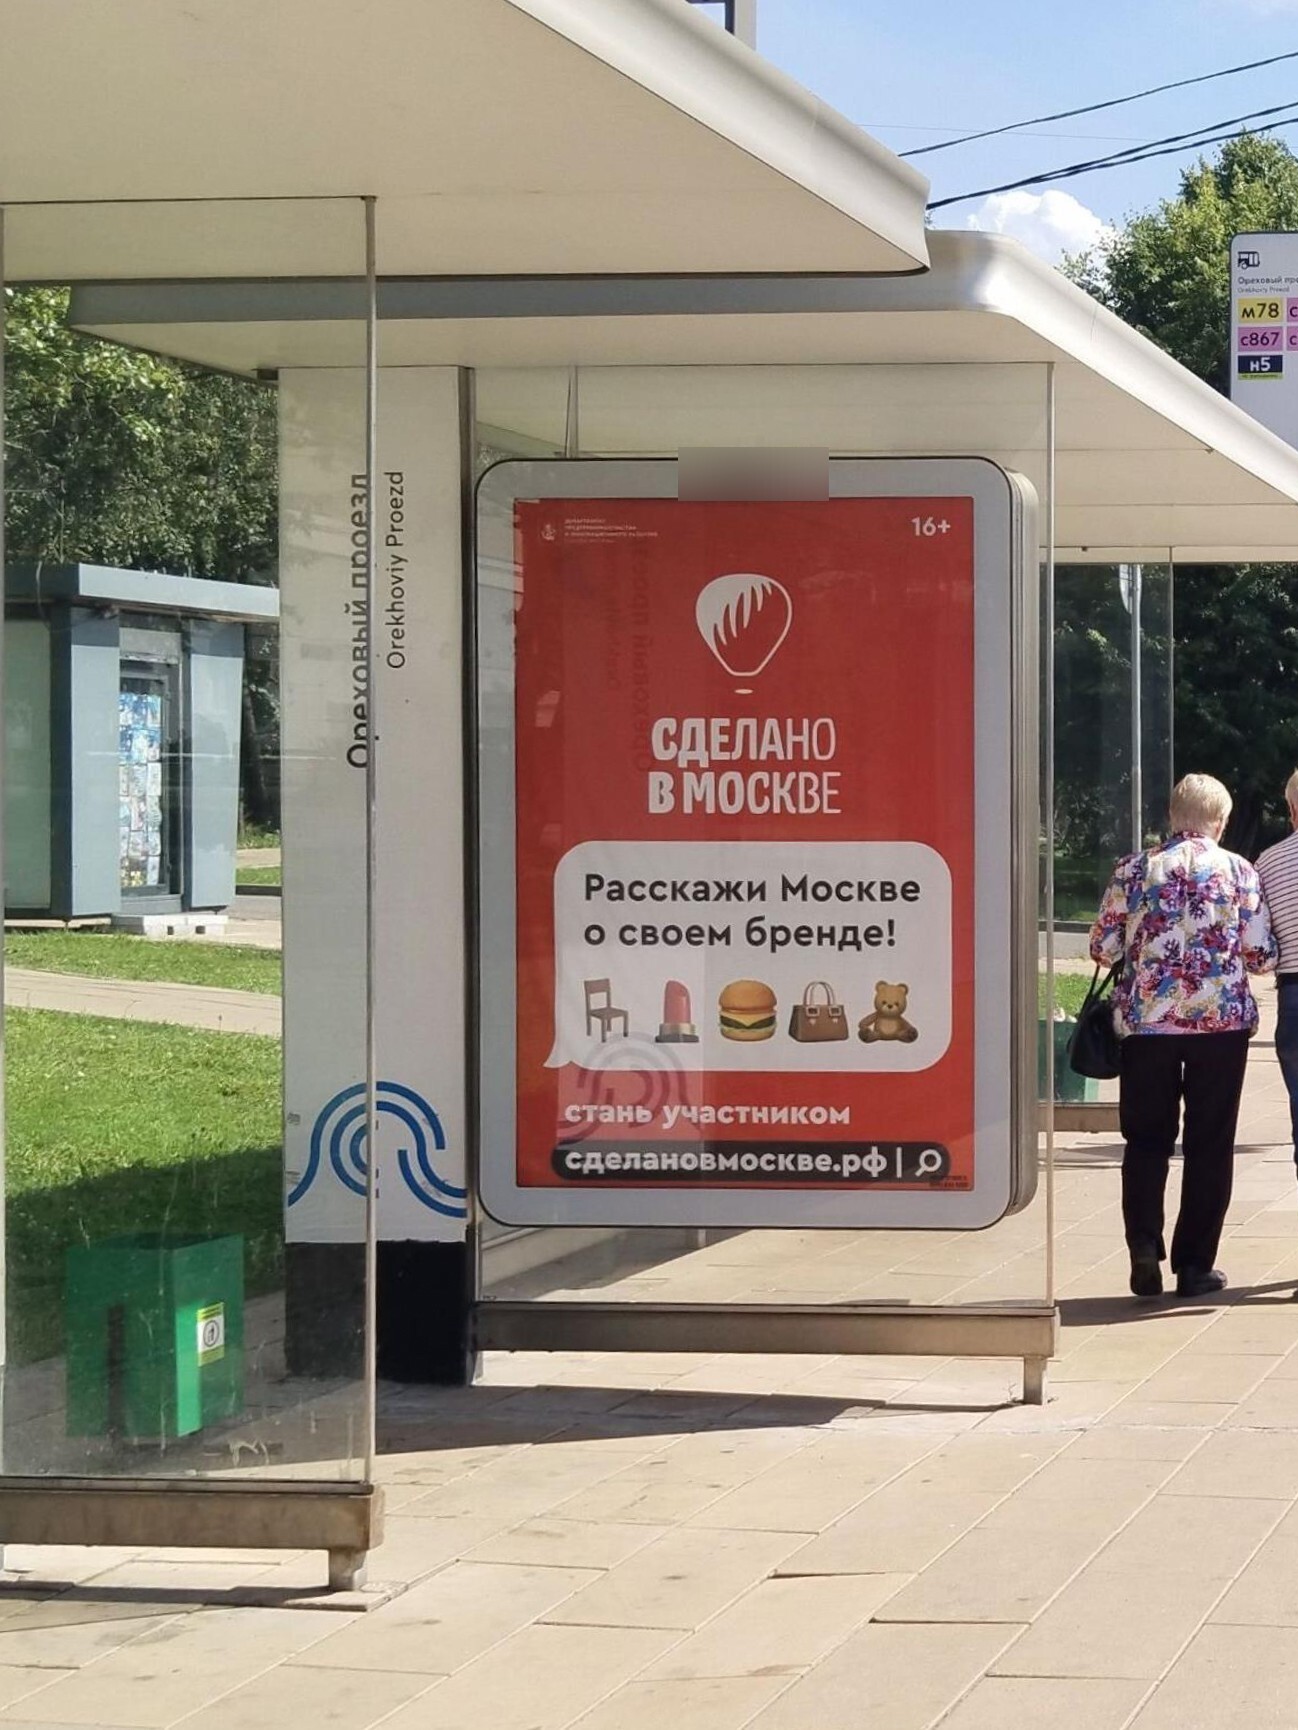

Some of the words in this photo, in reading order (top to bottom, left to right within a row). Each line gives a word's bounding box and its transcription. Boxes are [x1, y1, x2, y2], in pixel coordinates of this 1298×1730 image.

[1241, 302, 1280, 318] м78
[1240, 332, 1280, 346] с867
[384, 471, 404, 547] Proezd
[911, 516, 951, 537] 16+
[385, 554, 409, 669] Orekhoviy
[651, 717, 837, 768] СДЕЛАНО
[648, 771, 675, 814] В
[683, 771, 842, 815] МОСКВЕ
[584, 873, 767, 902] Расскажи
[781, 874, 921, 902] Москве
[584, 924, 606, 946] о
[618, 924, 731, 946] своем
[745, 915, 896, 953] бренде!
[564, 1104, 653, 1124] стань
[661, 1104, 850, 1130] участником
[564, 1146, 888, 1178] сделановмоскве.рф
